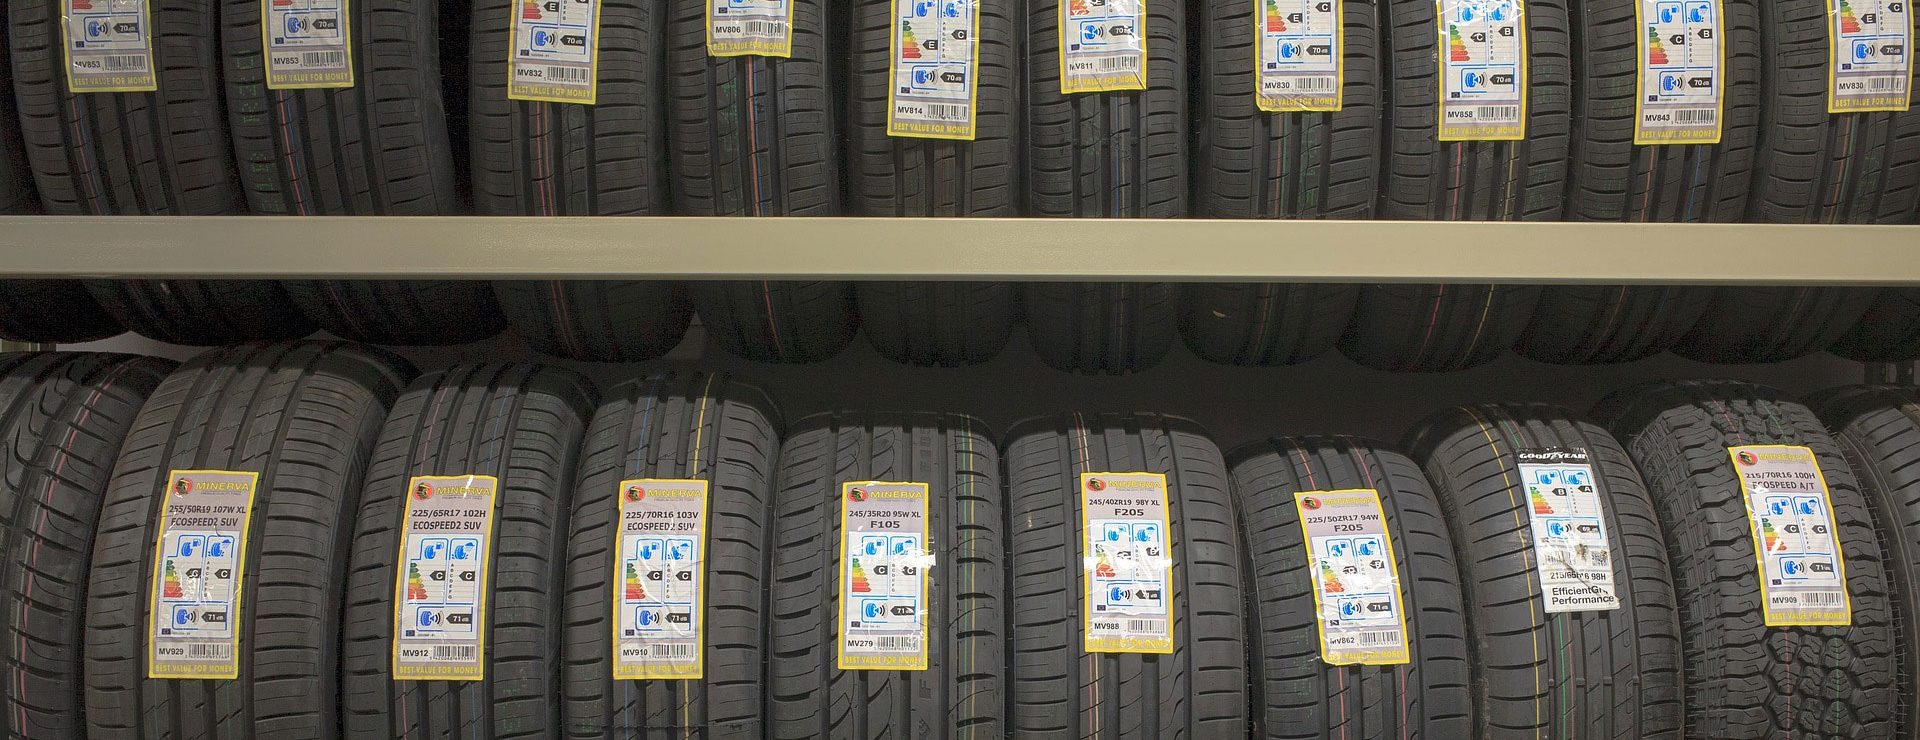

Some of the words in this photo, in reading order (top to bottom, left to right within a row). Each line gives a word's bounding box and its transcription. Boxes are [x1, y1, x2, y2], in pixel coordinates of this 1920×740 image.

[518, 69, 542, 77] MV832
[894, 122, 908, 130] BEST
[932, 124, 944, 132] FOR
[947, 125, 969, 133] MONEY
[196, 482, 249, 491] MINERVA
[436, 486, 490, 496] MINERVA
[1800, 482, 1814, 491] A/T
[648, 489, 702, 497] MINERVA
[169, 505, 210, 514] 255/50R19
[236, 506, 246, 514] XL
[412, 510, 460, 518] 225/65R17
[463, 510, 486, 518] 102H
[849, 510, 890, 518] 245/35R20
[626, 511, 673, 520] 225/70R16
[1307, 515, 1358, 523] 225/50ZR17
[171, 518, 218, 526] ECOSPEED2
[220, 518, 238, 526] SUV
[413, 521, 461, 530] ECOSPEED2
[464, 522, 481, 530] SUV
[628, 522, 675, 531] ECOSPEED2
[678, 522, 695, 531] SUV
[871, 521, 900, 529] F105
[1334, 524, 1363, 532] F205
[1552, 586, 1608, 595] EfficientGr
[1552, 595, 1614, 605] Performance
